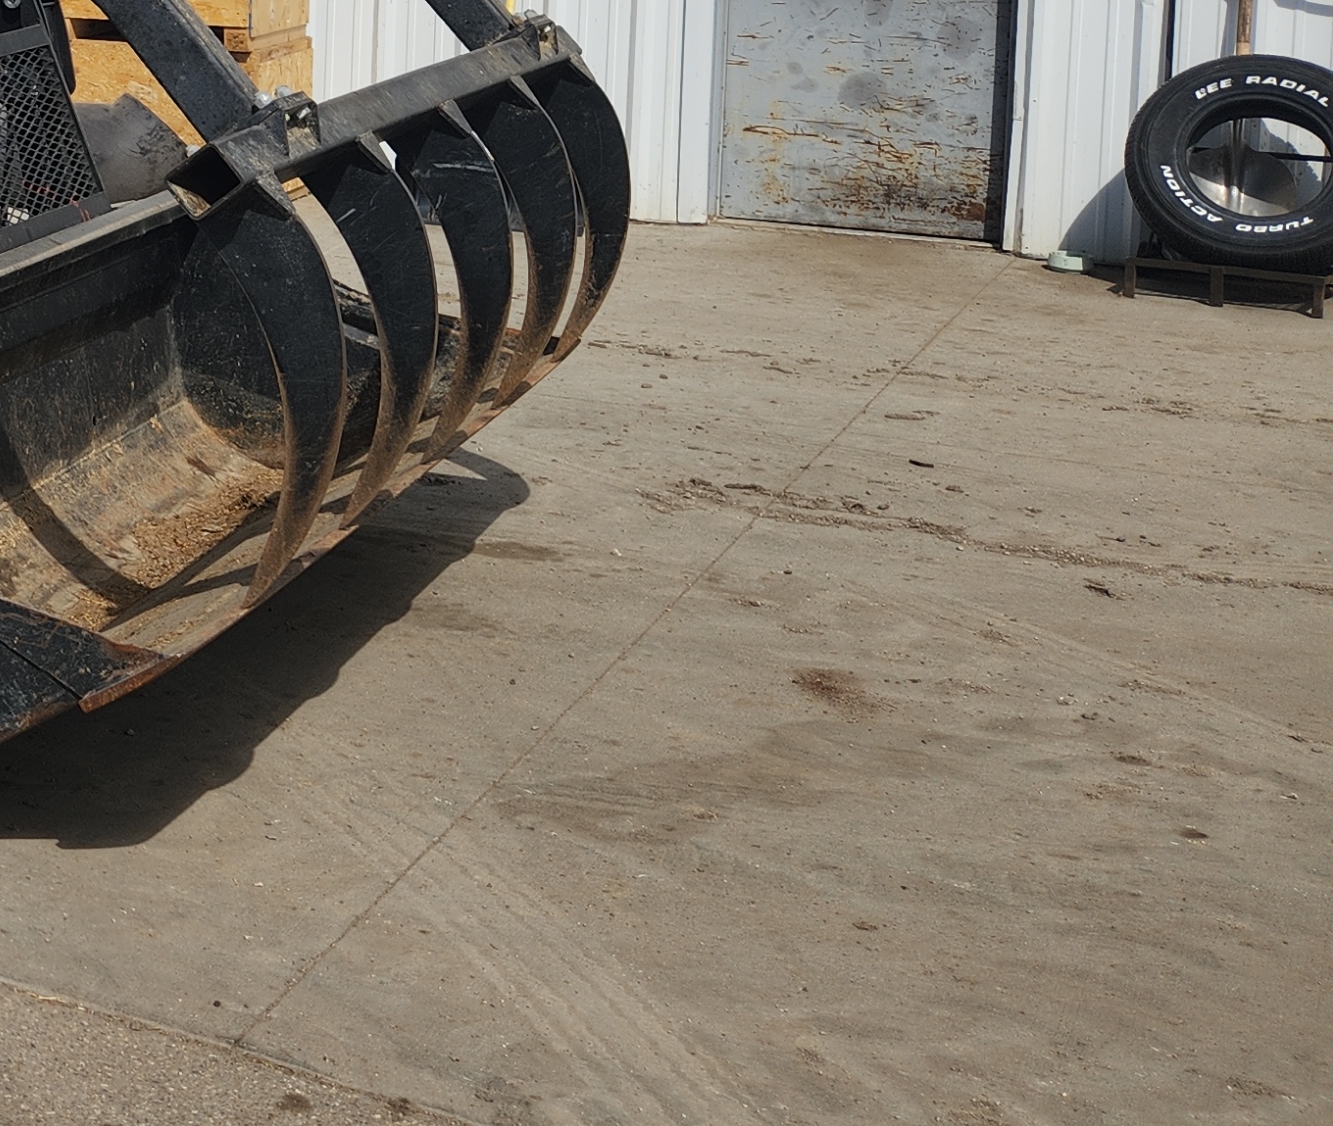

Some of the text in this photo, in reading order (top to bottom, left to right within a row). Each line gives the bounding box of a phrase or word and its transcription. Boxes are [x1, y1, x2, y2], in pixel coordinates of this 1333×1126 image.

[1194, 75, 1329, 108] LEE RADIAL
[1160, 164, 1314, 233] TURBO ACTION
